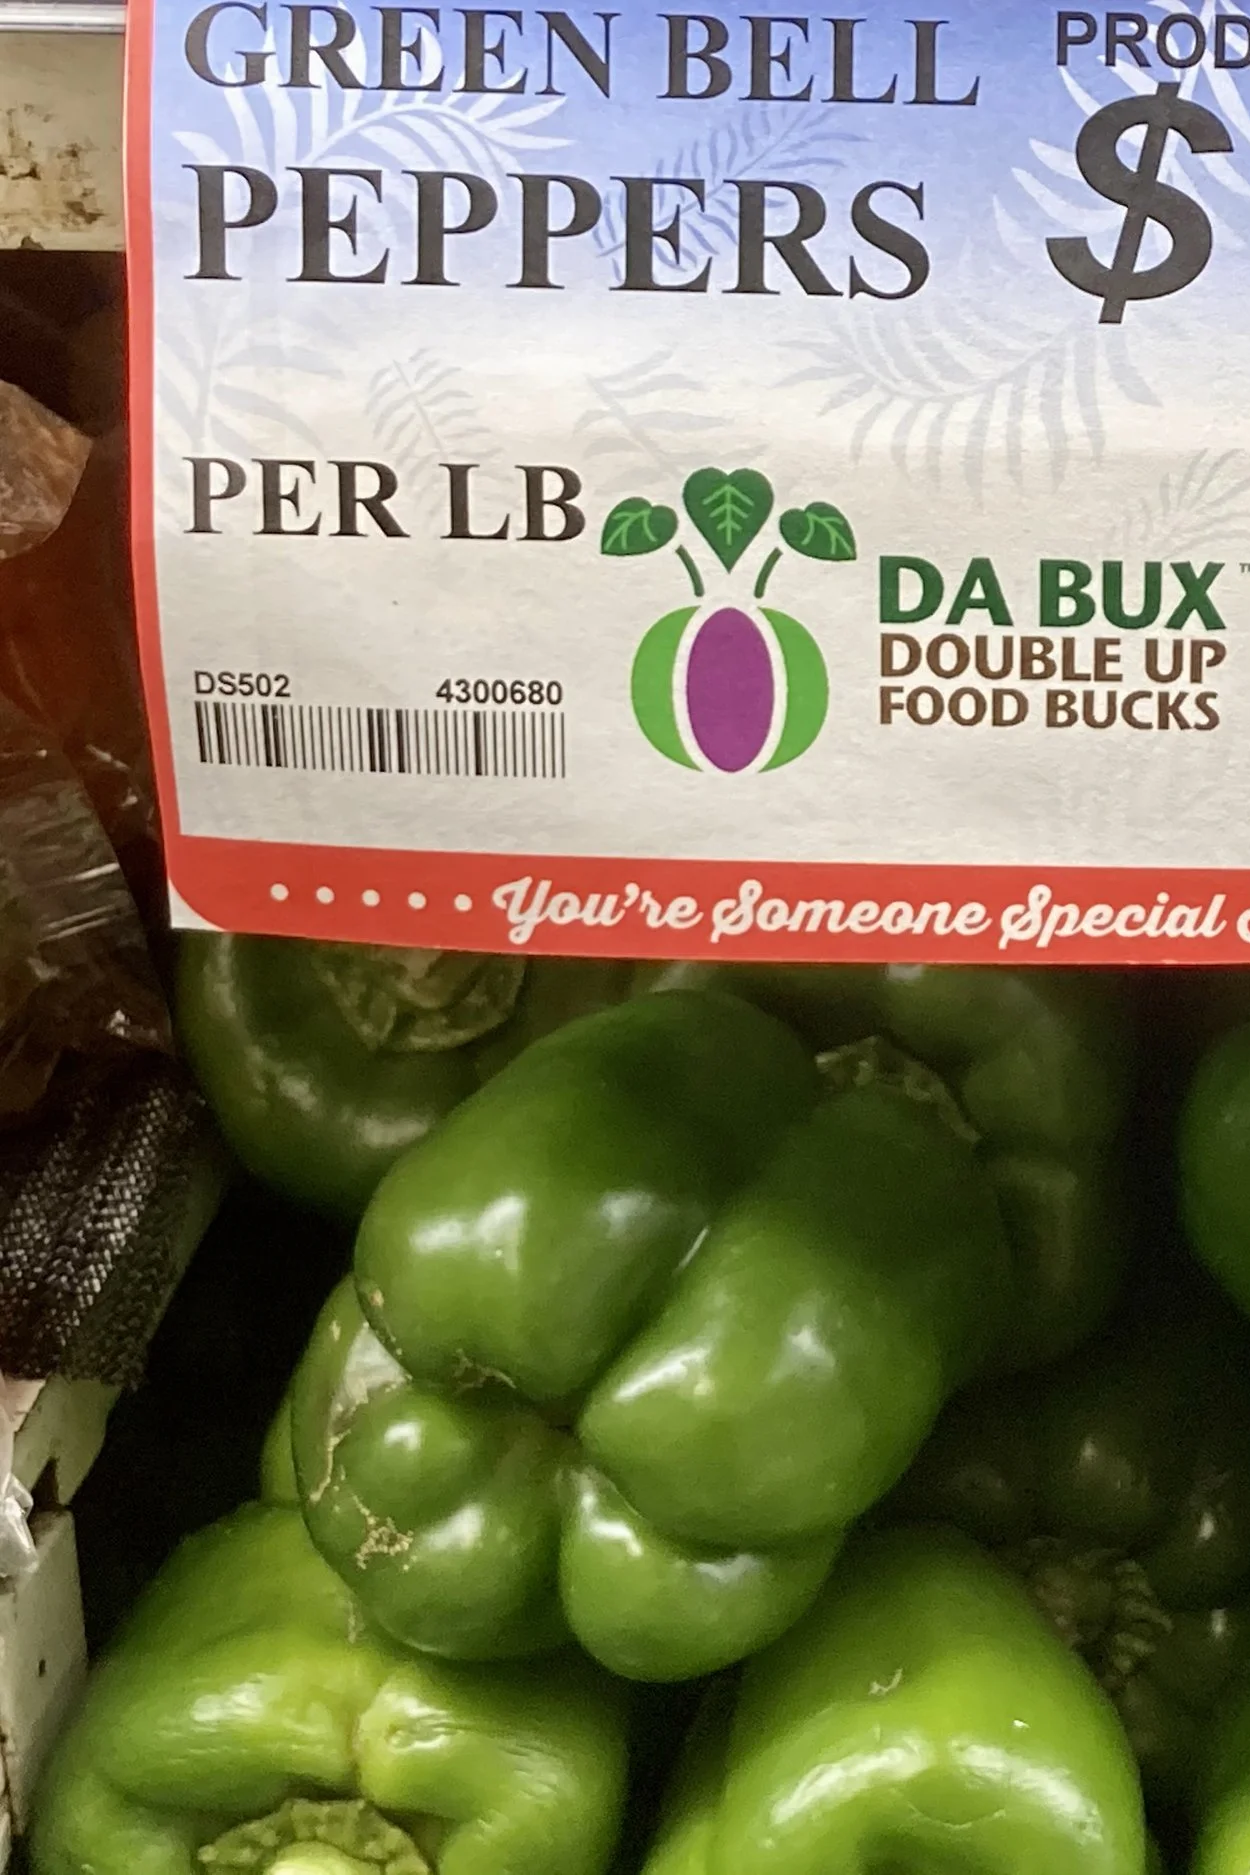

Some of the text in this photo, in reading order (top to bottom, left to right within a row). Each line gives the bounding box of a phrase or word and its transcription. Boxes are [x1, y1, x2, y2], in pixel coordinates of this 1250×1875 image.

[183, 0, 981, 107] GREEN BELL
[181, 163, 931, 301] PEPPERS
[182, 456, 587, 542] PER LB
[878, 554, 1015, 627] DA
[1038, 558, 1228, 631] BUX
[193, 669, 292, 698] DS502
[434, 677, 564, 706] 4300680
[879, 632, 1228, 685] DOUBLE UP
[878, 685, 1222, 732] FOOD BUCKS
[710, 878, 992, 944] Someone
[998, 883, 1227, 951] Special
